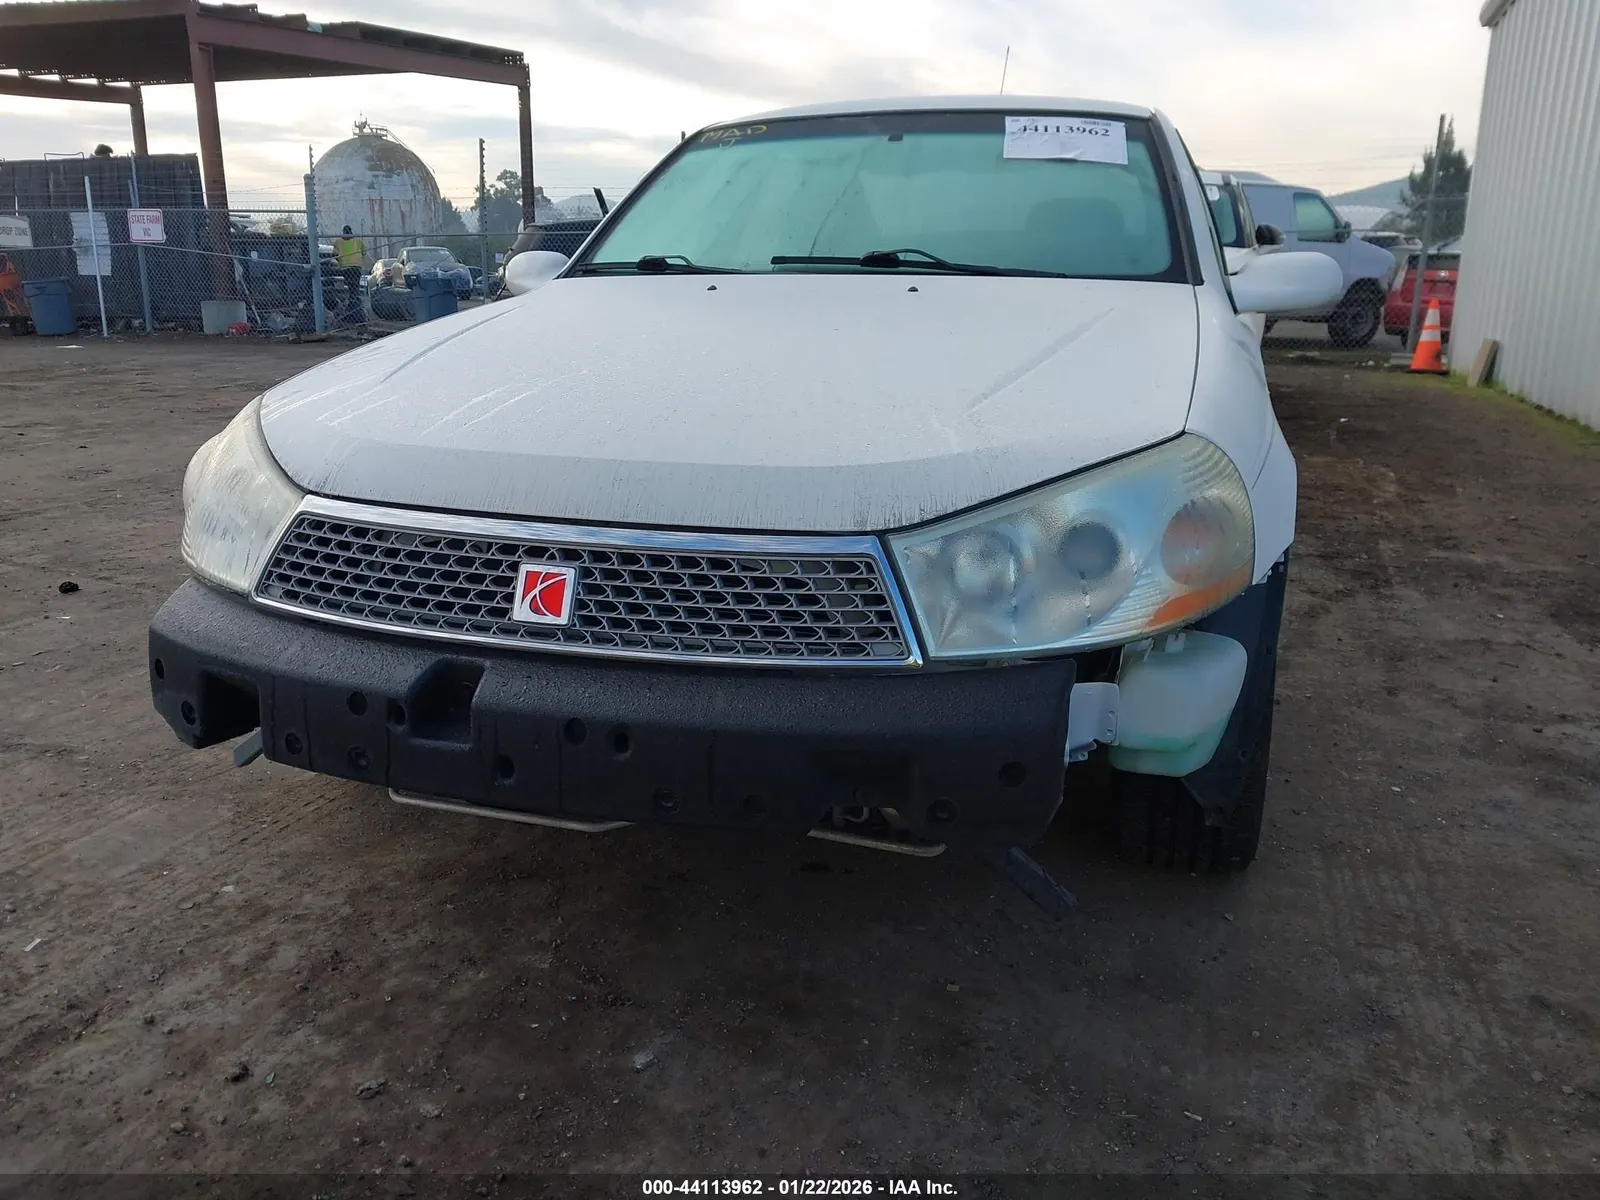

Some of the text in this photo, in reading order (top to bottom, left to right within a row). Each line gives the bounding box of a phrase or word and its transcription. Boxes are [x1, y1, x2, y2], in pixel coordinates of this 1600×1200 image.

[1018, 124, 1110, 137] 44113962
[131, 214, 161, 225] STATE FARM
[15, 226, 29, 237] ZONE
